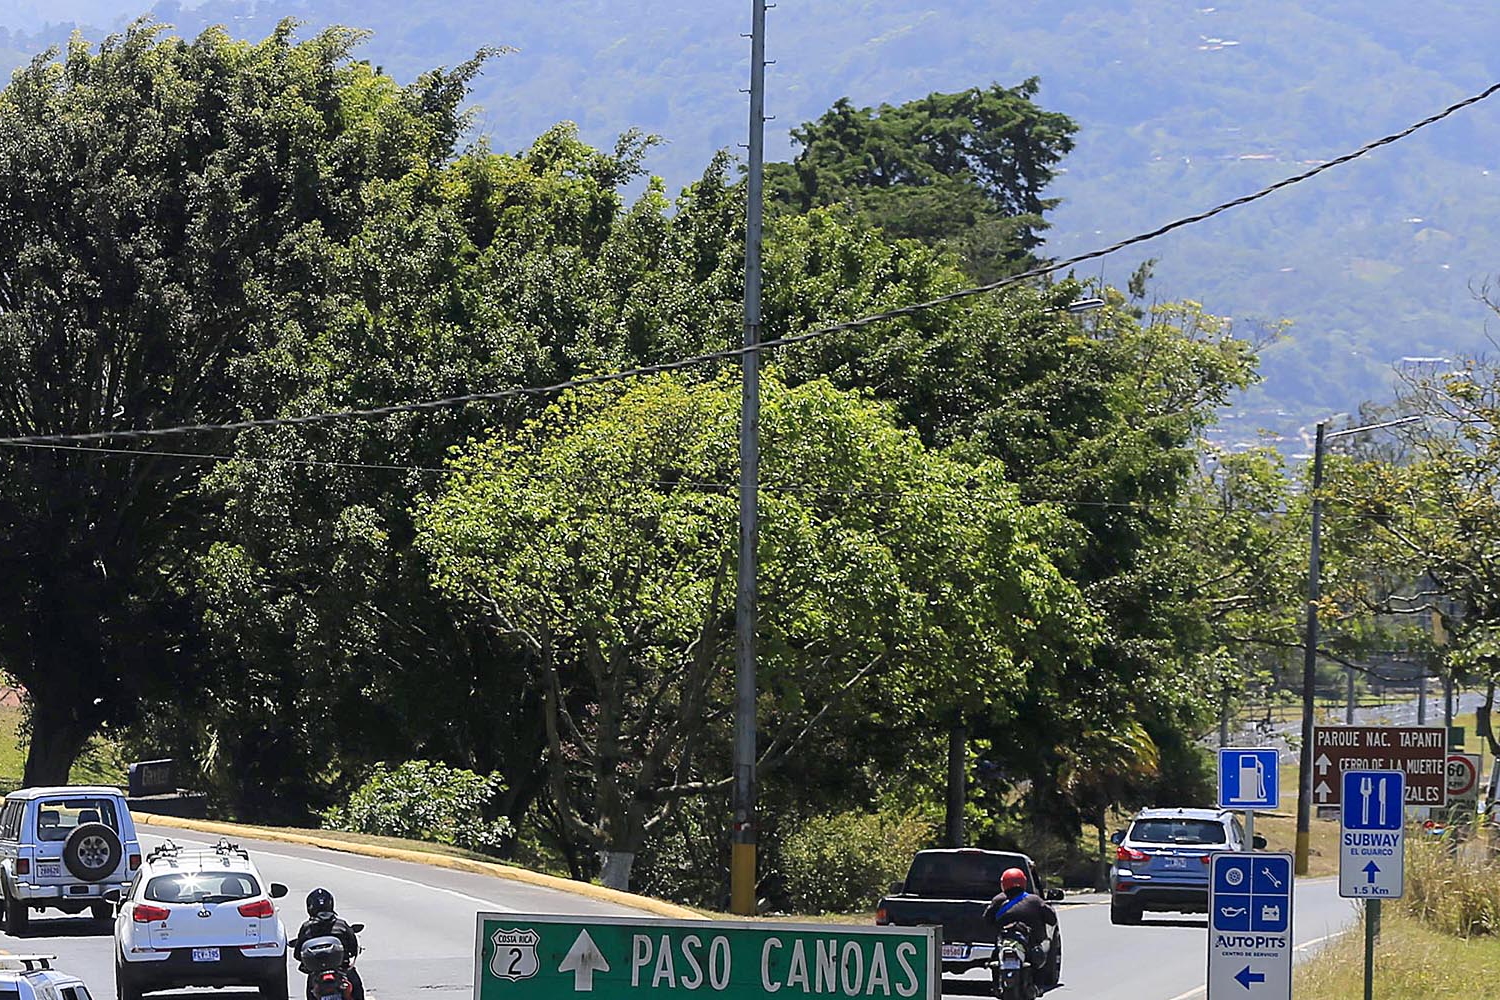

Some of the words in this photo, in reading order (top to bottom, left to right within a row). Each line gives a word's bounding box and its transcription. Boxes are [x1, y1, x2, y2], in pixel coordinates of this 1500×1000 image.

[1318, 731, 1360, 747] PARQUE
[1366, 732, 1391, 748] NAC.
[1399, 732, 1442, 748] TAPANTI
[1406, 759, 1444, 775] MUERTE
[1447, 763, 1465, 777] 60
[1344, 833, 1400, 847] SUBWAY
[1350, 848, 1359, 856] EL
[1361, 848, 1393, 856] GUARCO
[1353, 886, 1368, 895] 1.5
[1371, 886, 1389, 895] Km
[499, 934, 518, 944] COSTA
[518, 935, 533, 945] RICA
[507, 947, 523, 976] 2
[630, 933, 732, 993] PASO
[760, 937, 920, 998] CANOAS
